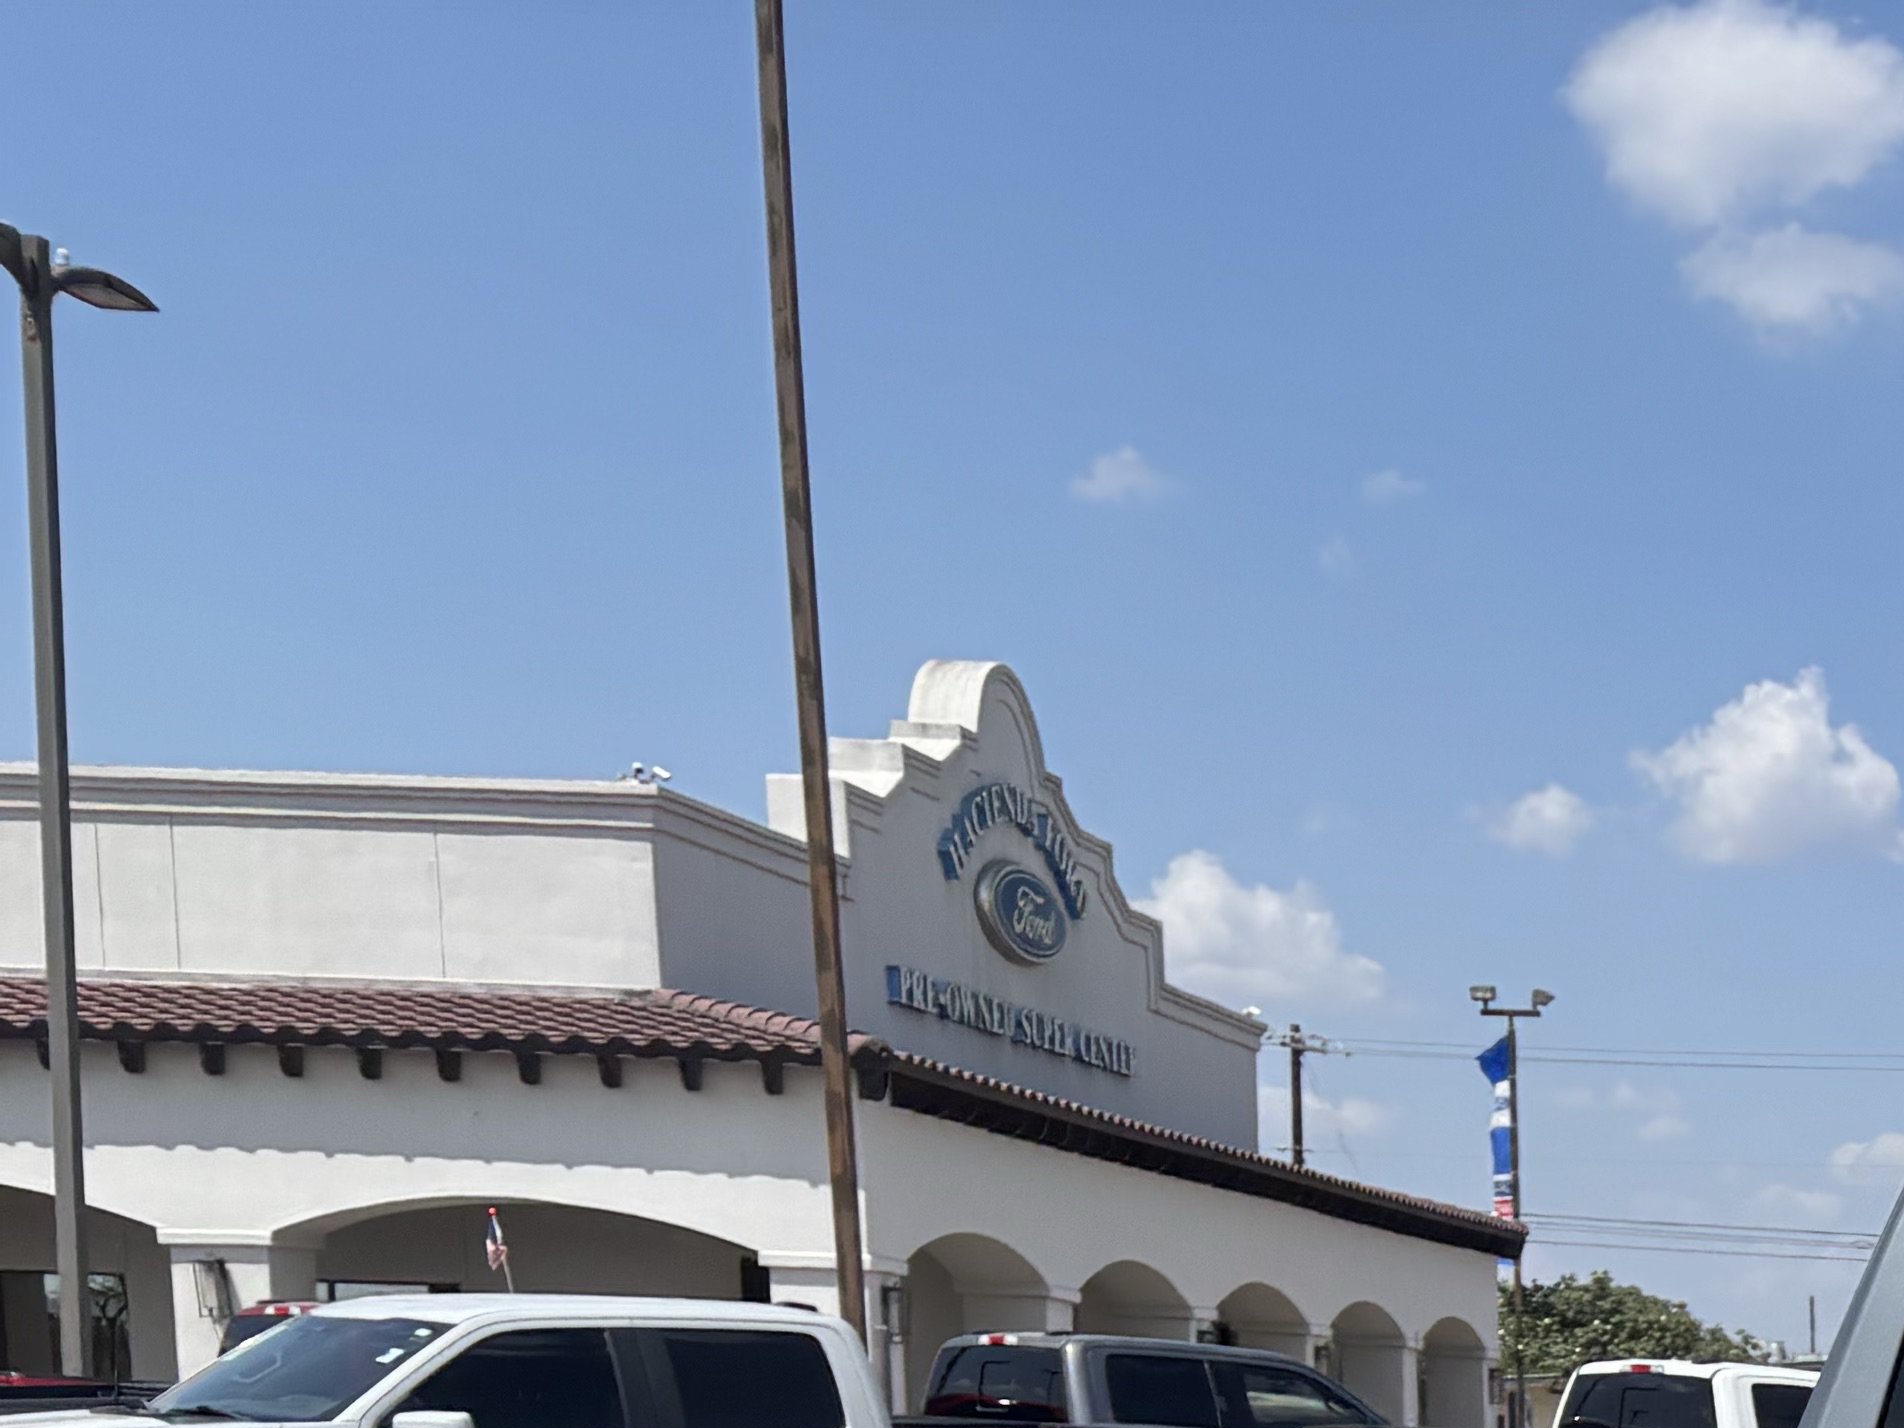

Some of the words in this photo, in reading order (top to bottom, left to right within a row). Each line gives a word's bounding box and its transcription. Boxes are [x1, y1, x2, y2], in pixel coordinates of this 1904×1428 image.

[942, 783, 1040, 879] HACIENDA
[1013, 885, 1056, 945] Ford
[895, 966, 1015, 1038] PRE-OWNED
[1018, 1006, 1076, 1057] SUPER
